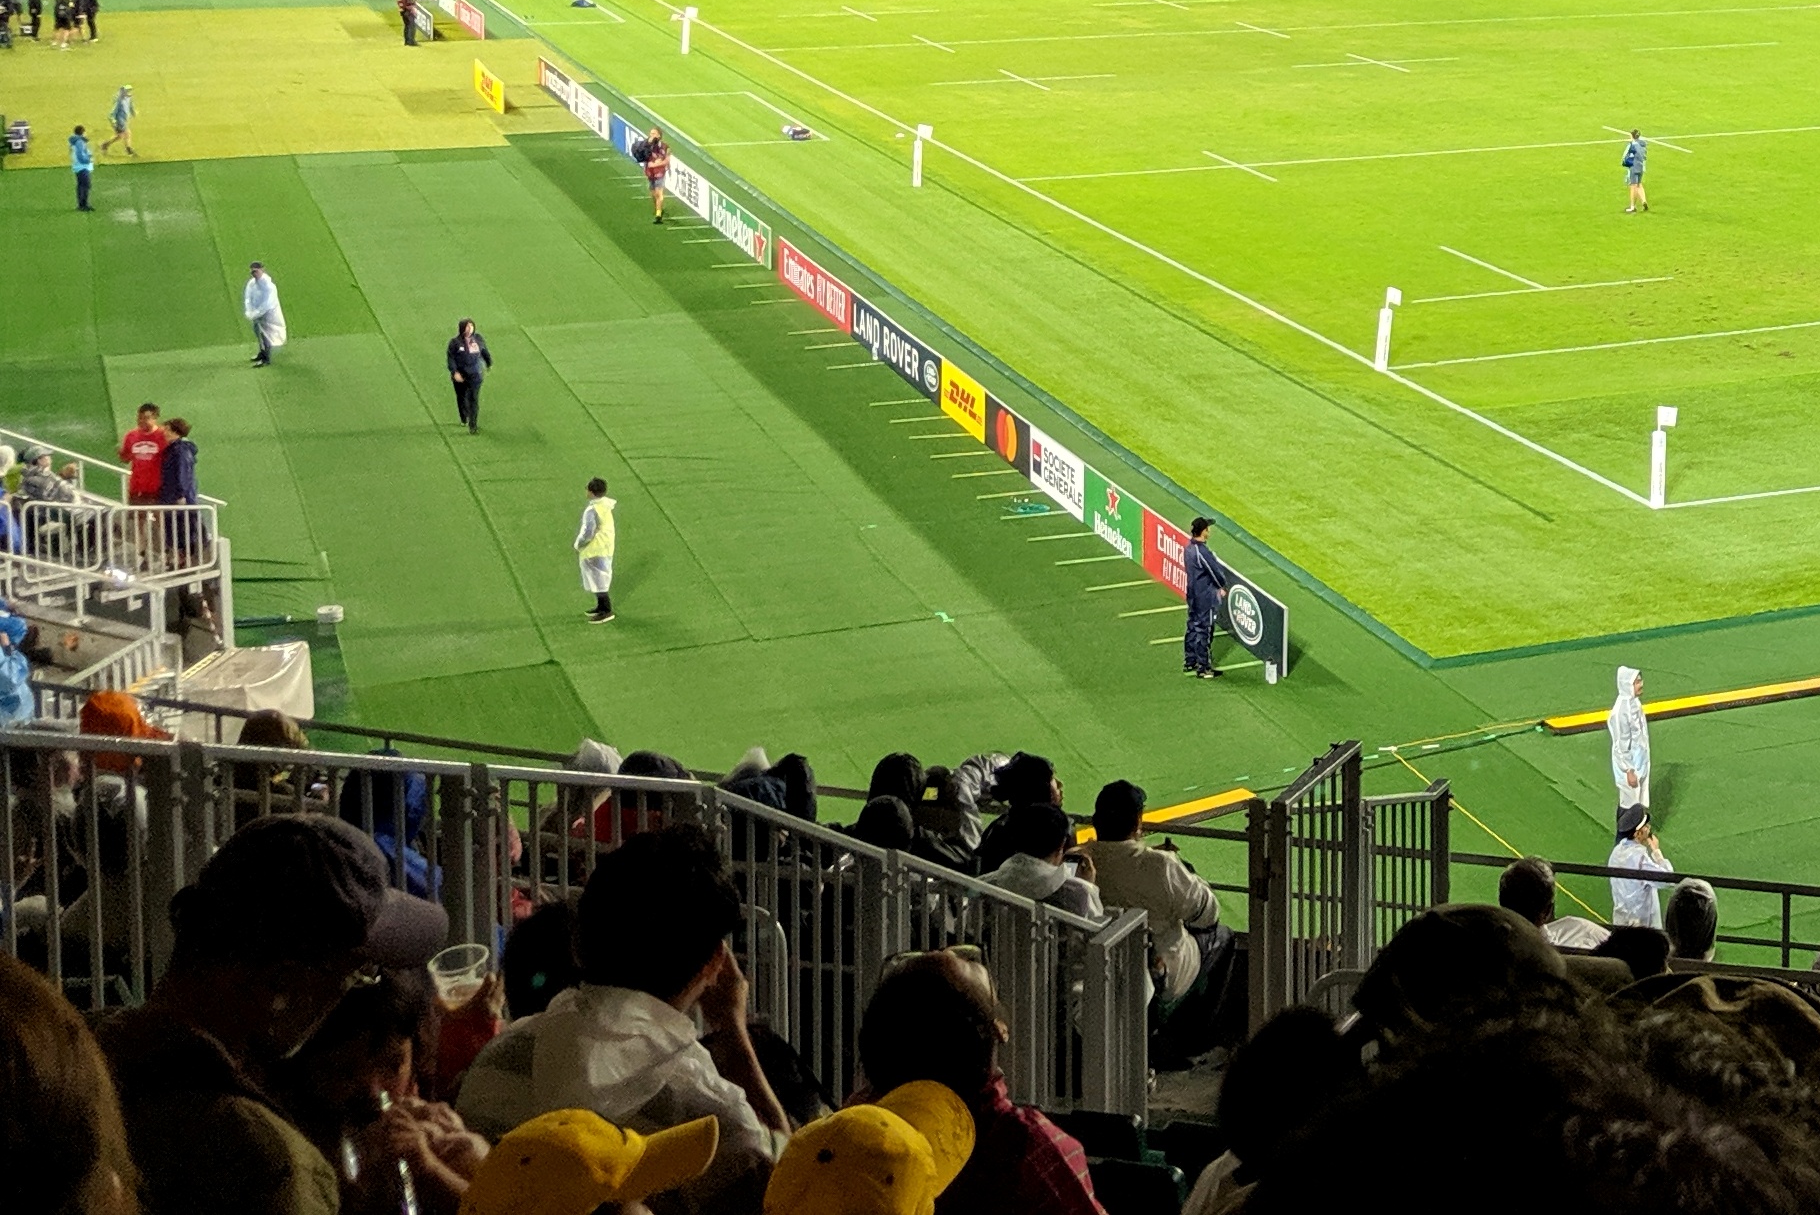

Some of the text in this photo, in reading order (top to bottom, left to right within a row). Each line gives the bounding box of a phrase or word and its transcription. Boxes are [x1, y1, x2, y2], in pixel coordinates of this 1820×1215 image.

[711, 190, 755, 258] Heineken
[783, 248, 815, 300] Emirates
[852, 303, 880, 350] LAND
[882, 325, 920, 382] ROVER
[949, 378, 978, 421] DHL
[1043, 447, 1076, 485] SOCIETE
[1043, 466, 1083, 510] GENERALE
[1094, 510, 1133, 560] Heineken
[1157, 524, 1185, 568] Emira
[1235, 593, 1252, 615] LAND
[1236, 613, 1257, 635] ROVER
